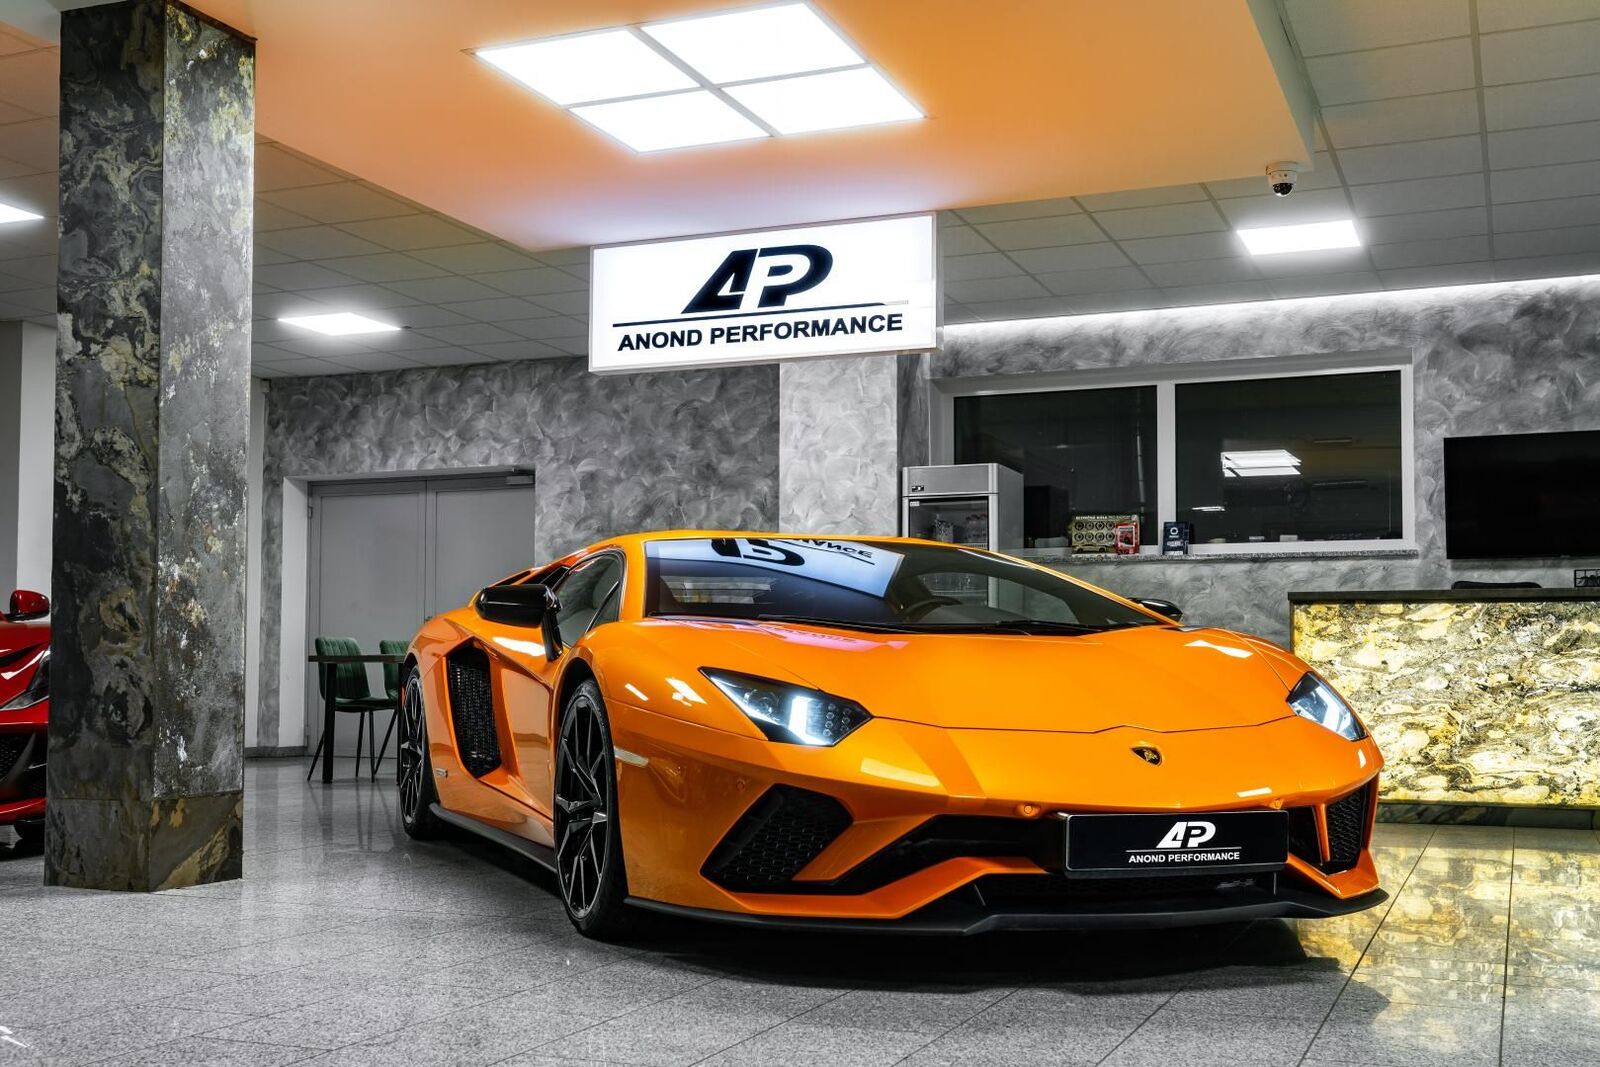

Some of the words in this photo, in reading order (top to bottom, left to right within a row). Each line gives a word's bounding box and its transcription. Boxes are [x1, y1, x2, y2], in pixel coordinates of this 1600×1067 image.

[681, 244, 833, 314] AP
[618, 329, 702, 351] ANOND
[710, 314, 903, 344] PERFORMANCE
[1156, 821, 1216, 848] AP
[1128, 855, 1166, 863] ANOND
[1168, 852, 1240, 862] PERFORMANCE
